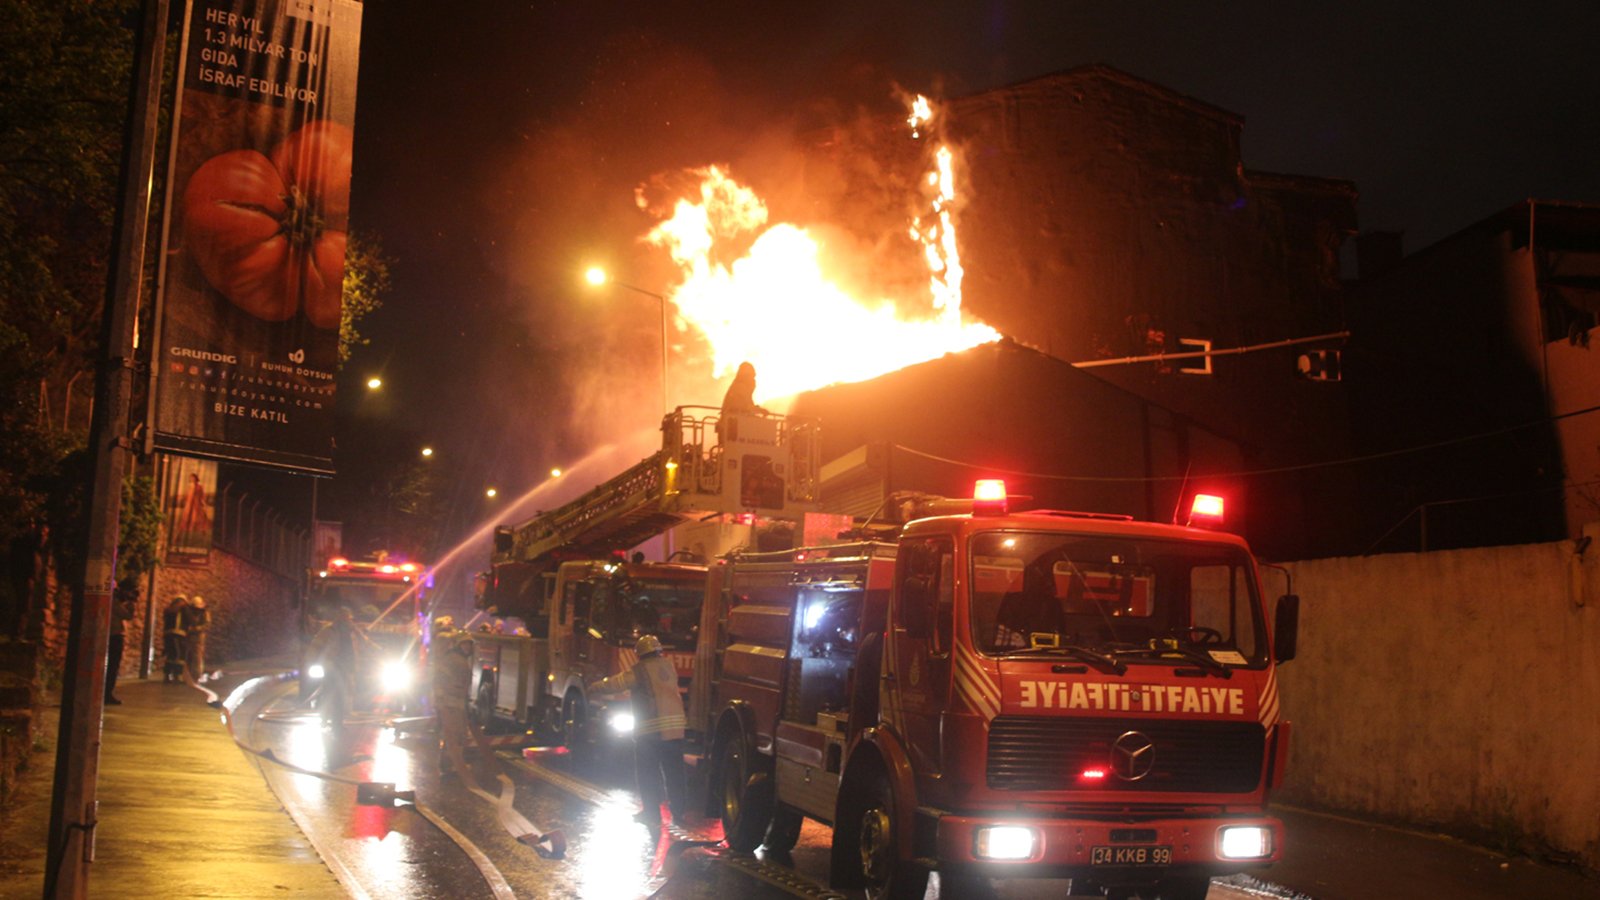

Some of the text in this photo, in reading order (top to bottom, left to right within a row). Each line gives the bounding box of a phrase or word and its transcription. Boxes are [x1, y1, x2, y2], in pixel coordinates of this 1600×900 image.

[206, 8, 264, 35] HER YIL
[201, 47, 238, 68] GIDA
[204, 28, 318, 67] 1.3 MİLYAR TON
[199, 64, 317, 105] İSRAF EDİLİYOR
[170, 346, 237, 365] GRUNDIG
[214, 402, 289, 424] BİZE KATIL
[1142, 683, 1244, 715] İTFAİYE
[1095, 847, 1169, 864] 34 KKB 99
